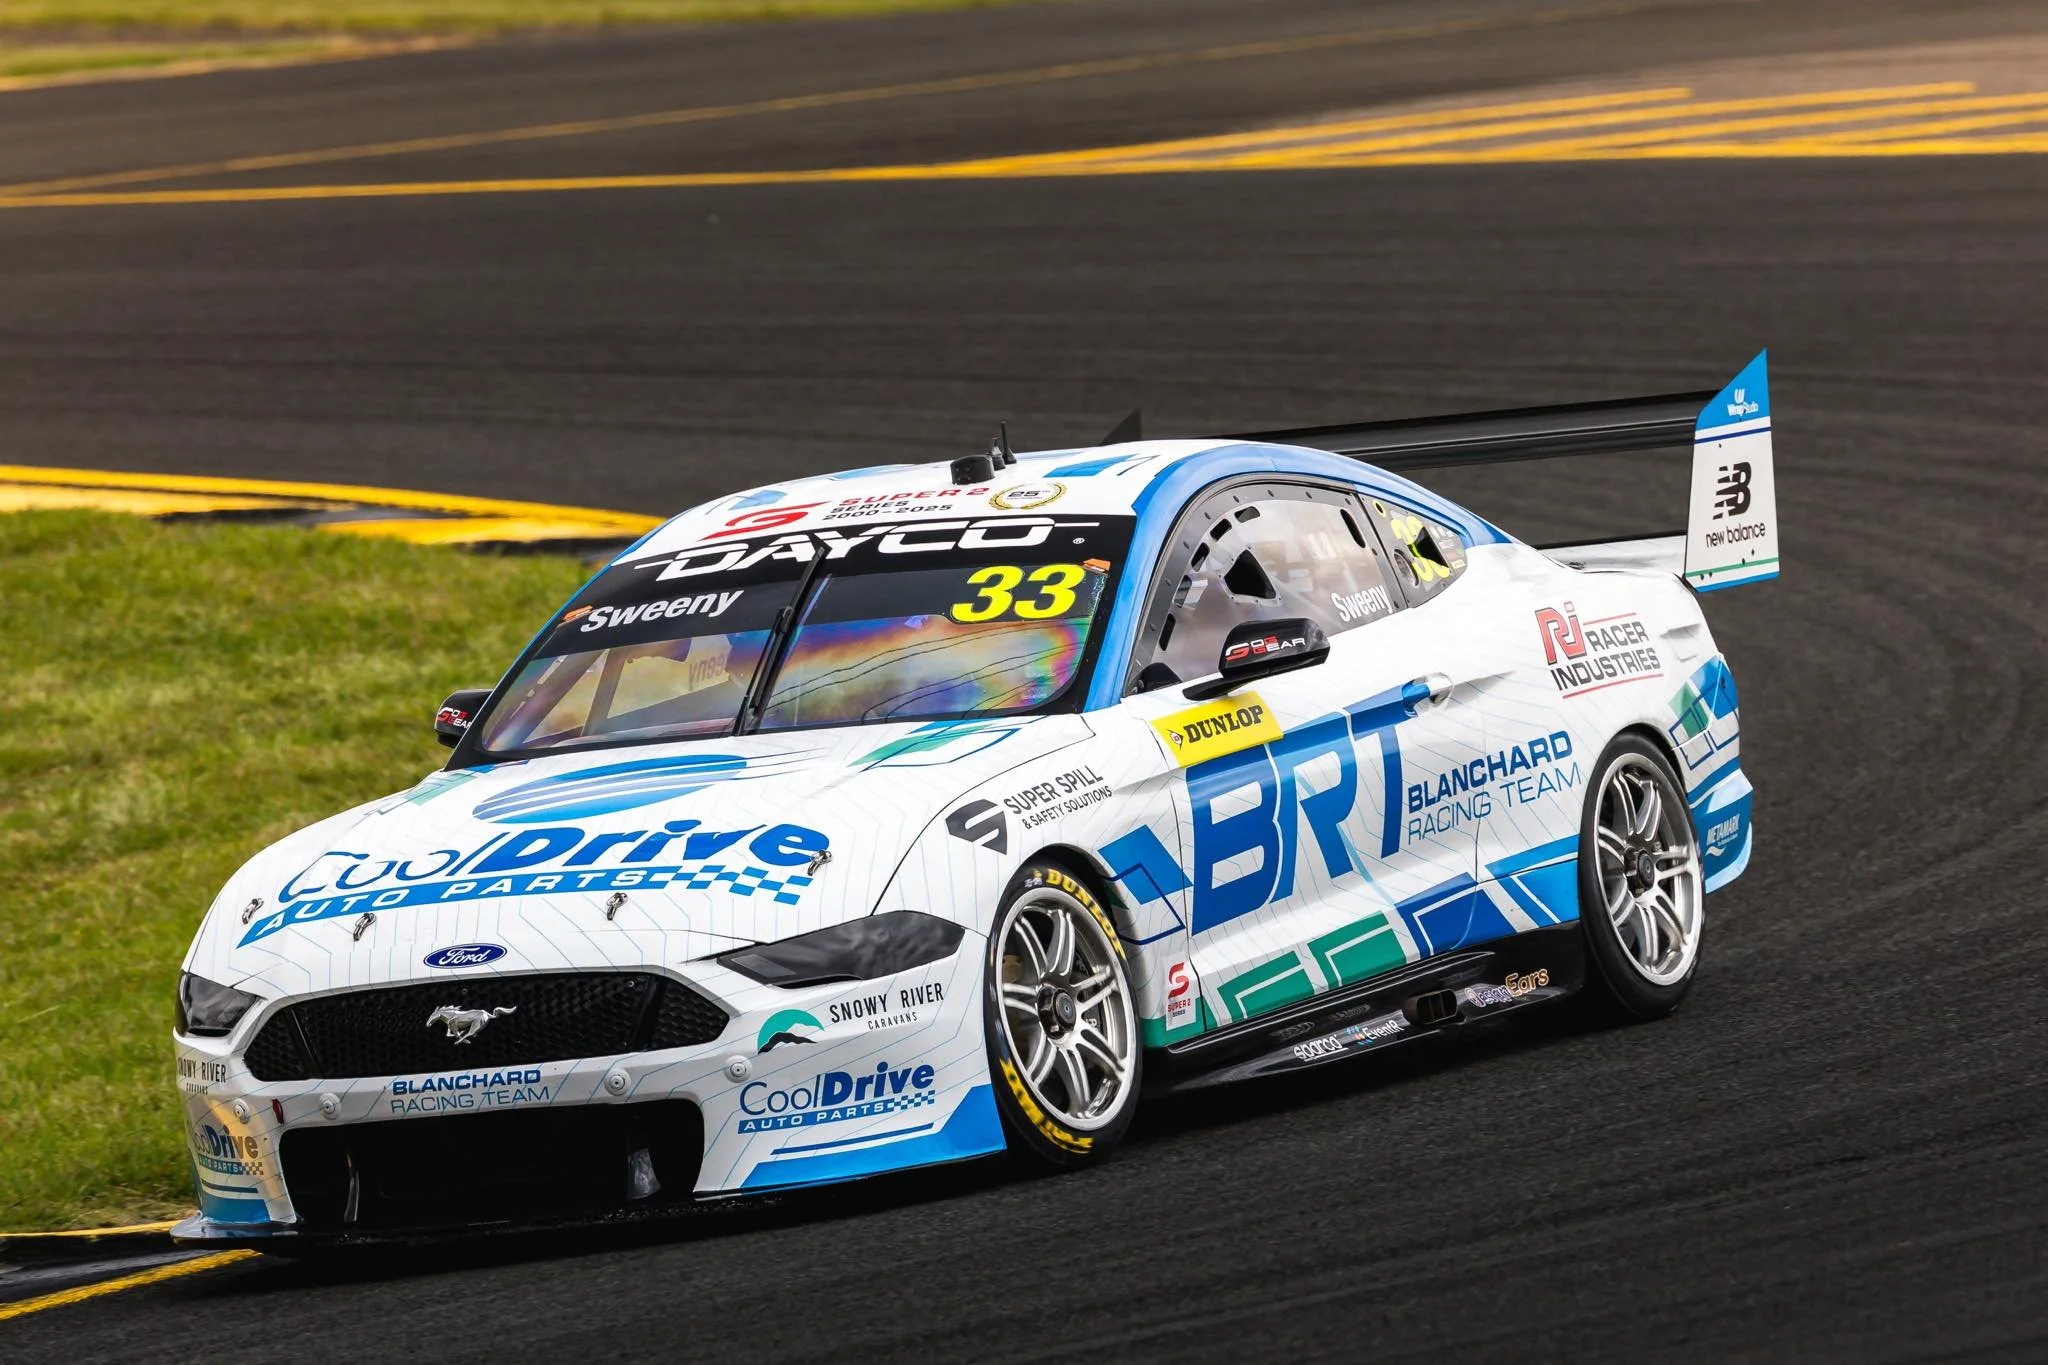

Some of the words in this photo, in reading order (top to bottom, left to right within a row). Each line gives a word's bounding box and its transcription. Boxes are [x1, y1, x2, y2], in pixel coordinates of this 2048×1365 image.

[822, 504, 953, 521] 2000-2025
[830, 501, 909, 514] SERIES
[839, 488, 961, 506] SUPER
[966, 487, 990, 496] 2
[655, 517, 1056, 582] DAYCO
[1705, 530, 1725, 548] new
[1727, 521, 1766, 545] balance
[952, 563, 1086, 622] 33
[1331, 585, 1393, 622] Sweeny
[580, 590, 744, 633] Sweeny
[1585, 621, 1650, 652] RACER
[1550, 647, 1661, 691] INDUSTRIES
[1182, 704, 1264, 744] DUNLOP
[1003, 781, 1057, 815] SUPER
[1055, 765, 1104, 793] SPILL
[1407, 730, 1573, 814] BLANCHARD
[1022, 818, 1032, 830] &
[1029, 806, 1065, 827] SAFETY
[1063, 785, 1113, 814] SOLUTIONS
[1185, 685, 1425, 937] BRT
[1408, 791, 1492, 846] RACING
[1499, 761, 1582, 808] TEAM
[278, 819, 830, 904] CoolDrive
[256, 888, 410, 937] AUTO
[440, 869, 648, 899] PARTS
[438, 946, 492, 967] Ford
[829, 993, 888, 1024] SNOWY
[900, 982, 945, 1009] RIVER
[867, 1011, 918, 1031] CARAVANS
[1168, 999, 1187, 1013] SUPER
[1187, 998, 1191, 1006] 2
[1293, 1034, 1344, 1060] sparco
[178, 1057, 197, 1079] NOWY
[201, 1061, 227, 1083] RIVER
[392, 1069, 541, 1096] BLANCHARD
[391, 1092, 475, 1115] RACING
[482, 1085, 550, 1106] TEAM
[739, 1061, 935, 1117] CoolDrive
[743, 1115, 803, 1132] AUTO
[815, 1102, 885, 1122] PARTS
[213, 1160, 240, 1174] PARTS
